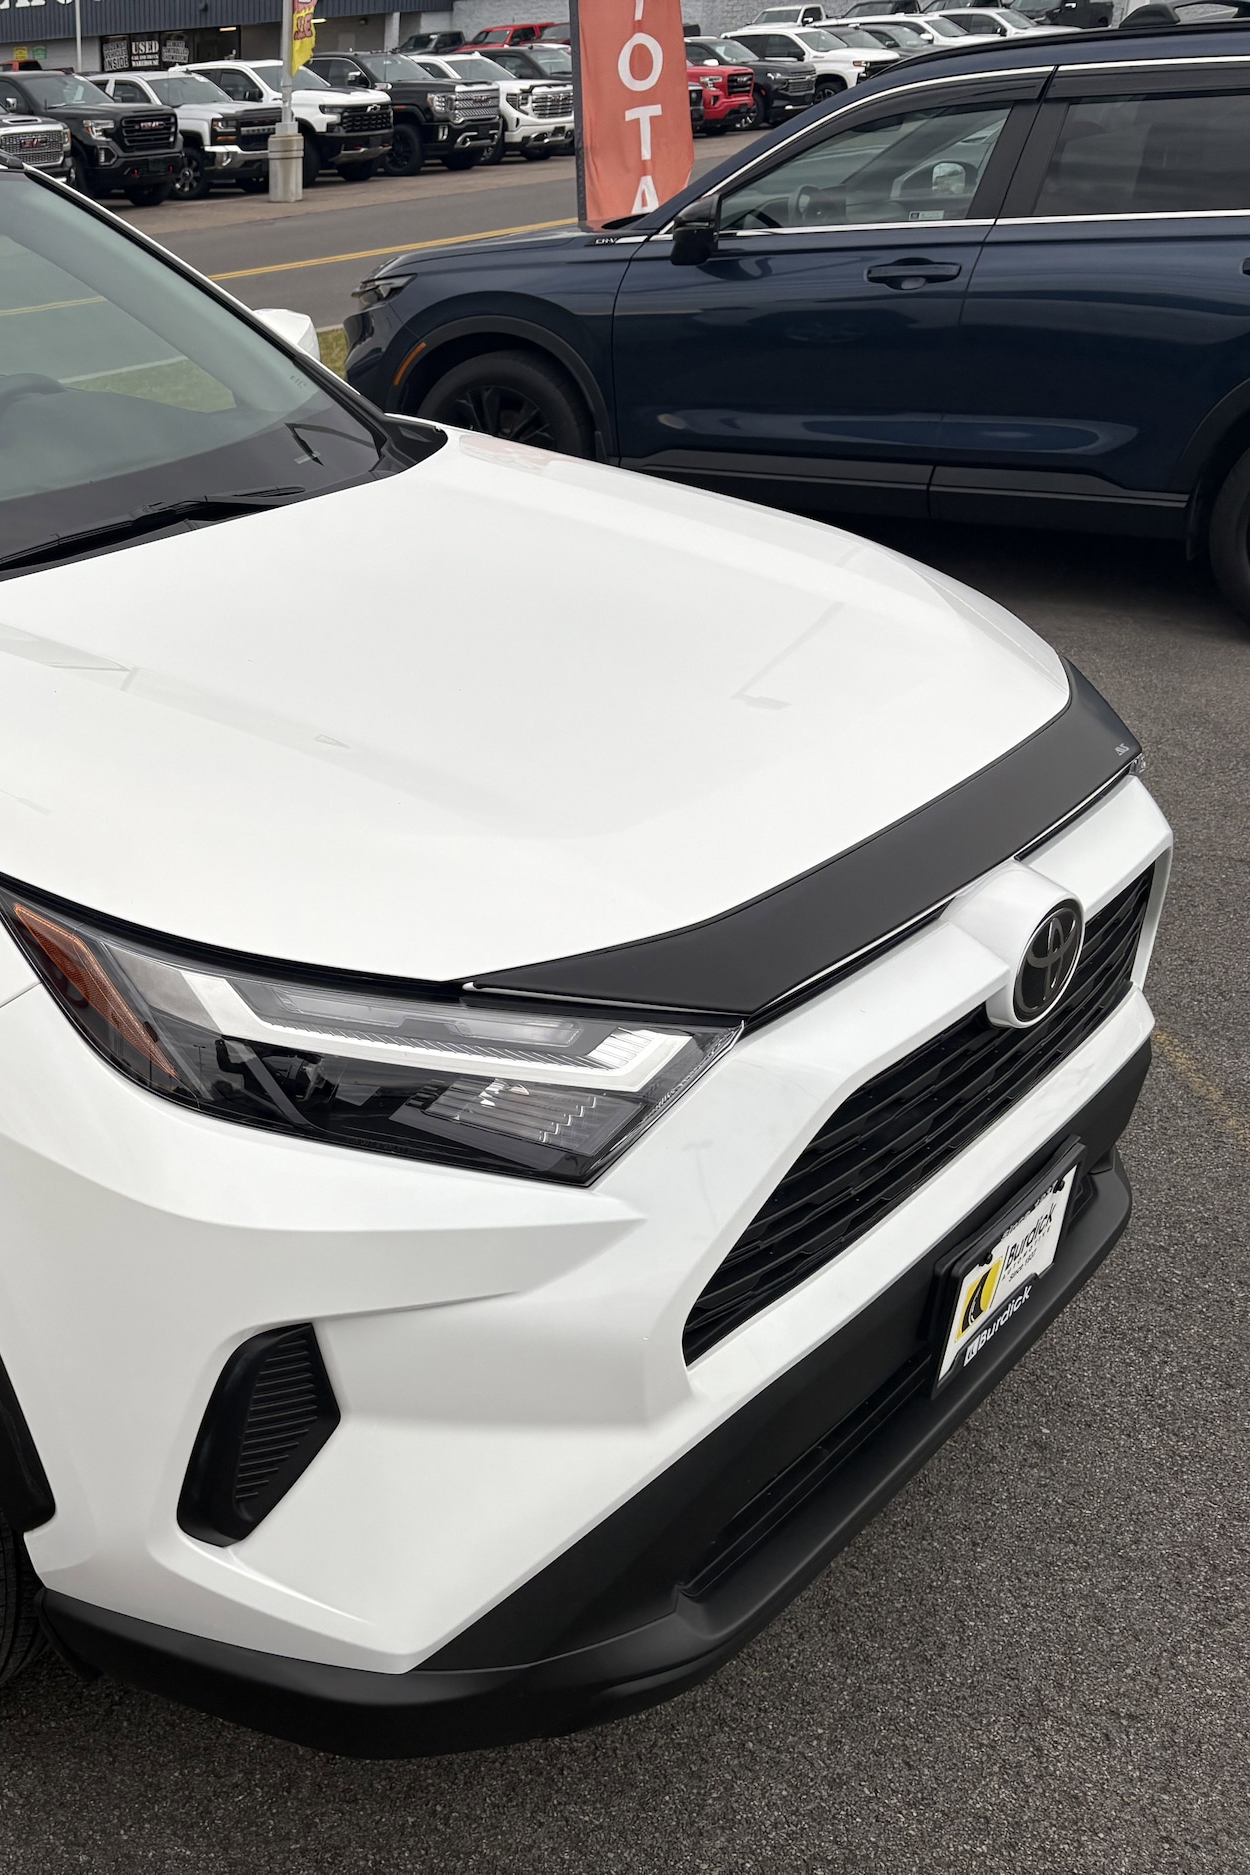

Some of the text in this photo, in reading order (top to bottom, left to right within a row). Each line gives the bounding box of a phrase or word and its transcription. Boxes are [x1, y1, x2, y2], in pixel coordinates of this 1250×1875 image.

[131, 41, 159, 54] USED
[1005, 1203, 1056, 1271] Burdick
[978, 1283, 1032, 1348] Burdick
